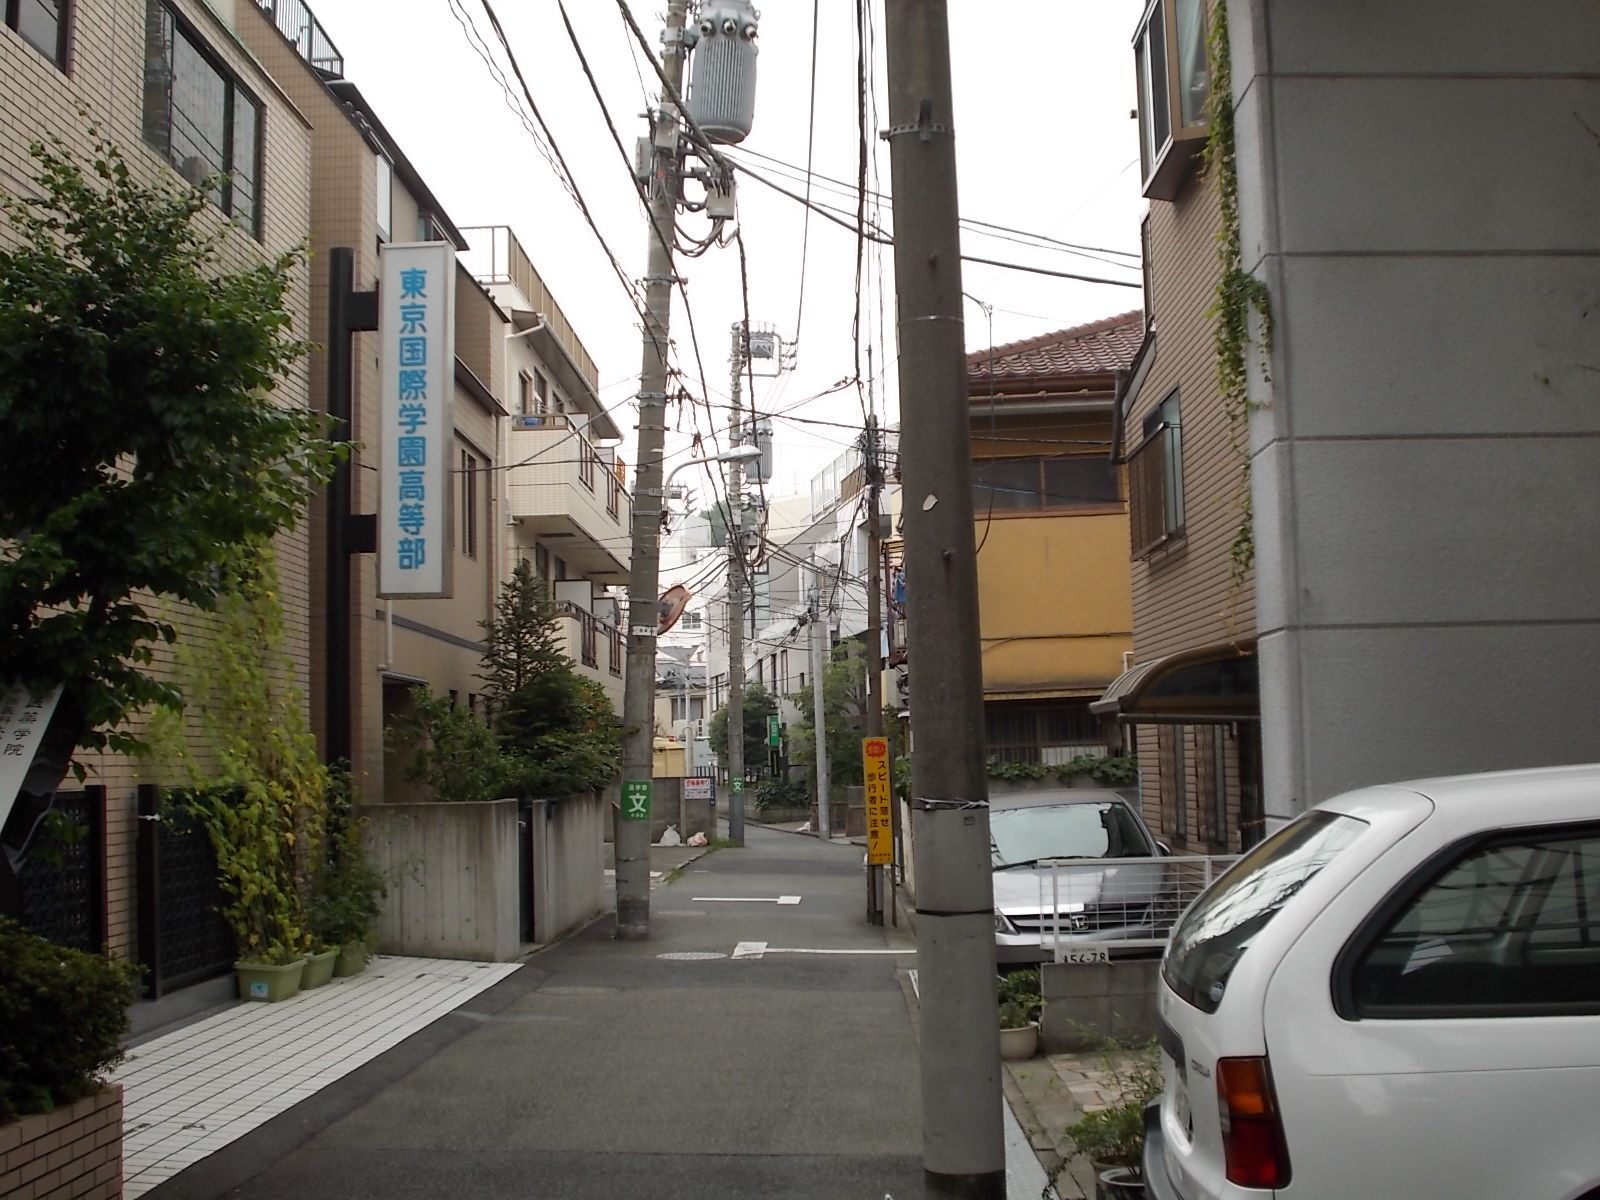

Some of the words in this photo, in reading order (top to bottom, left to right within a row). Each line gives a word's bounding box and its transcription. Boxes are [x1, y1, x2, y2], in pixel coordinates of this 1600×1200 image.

[398, 269, 427, 570] 東京国際学園高等部
[628, 793, 647, 813] 文
